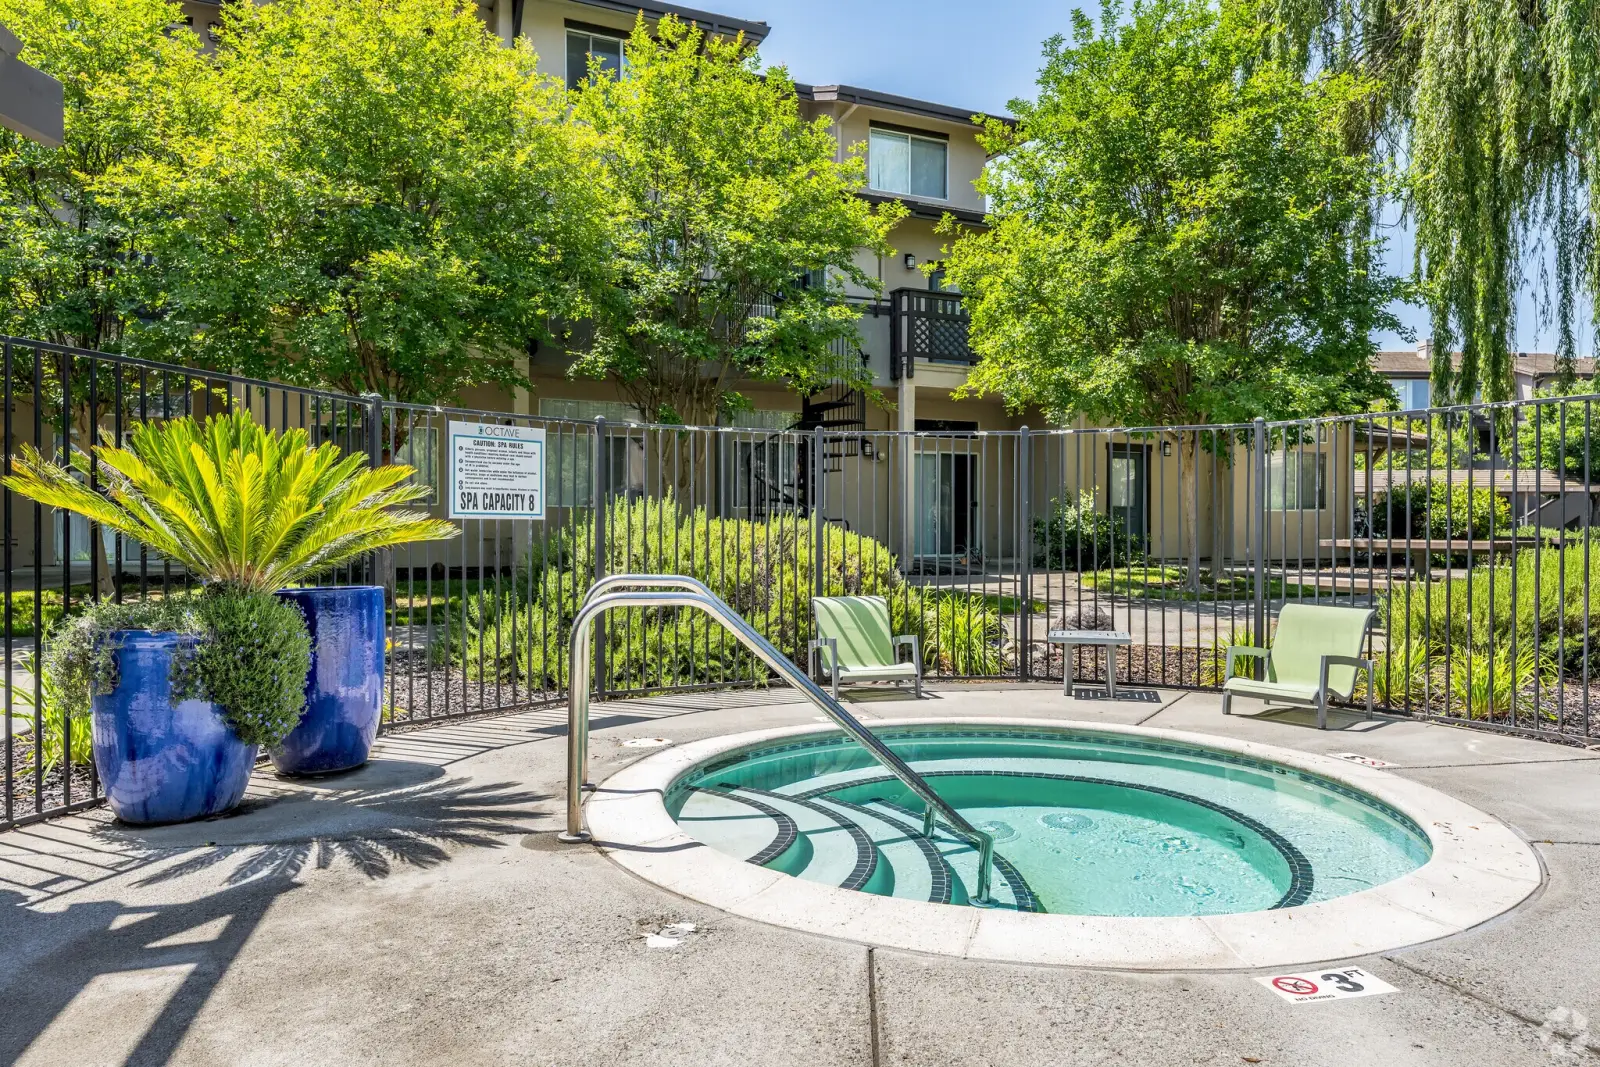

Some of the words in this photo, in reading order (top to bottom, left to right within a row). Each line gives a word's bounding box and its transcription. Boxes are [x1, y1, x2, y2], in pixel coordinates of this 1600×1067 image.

[485, 426, 519, 438] OCTAVE
[473, 440, 496, 448] CAUTION:
[460, 491, 479, 511] SPA
[482, 492, 525, 511] CAPACITY
[528, 494, 535, 511] 8
[1321, 973, 1364, 992] 3
[1343, 969, 1365, 978] FT
